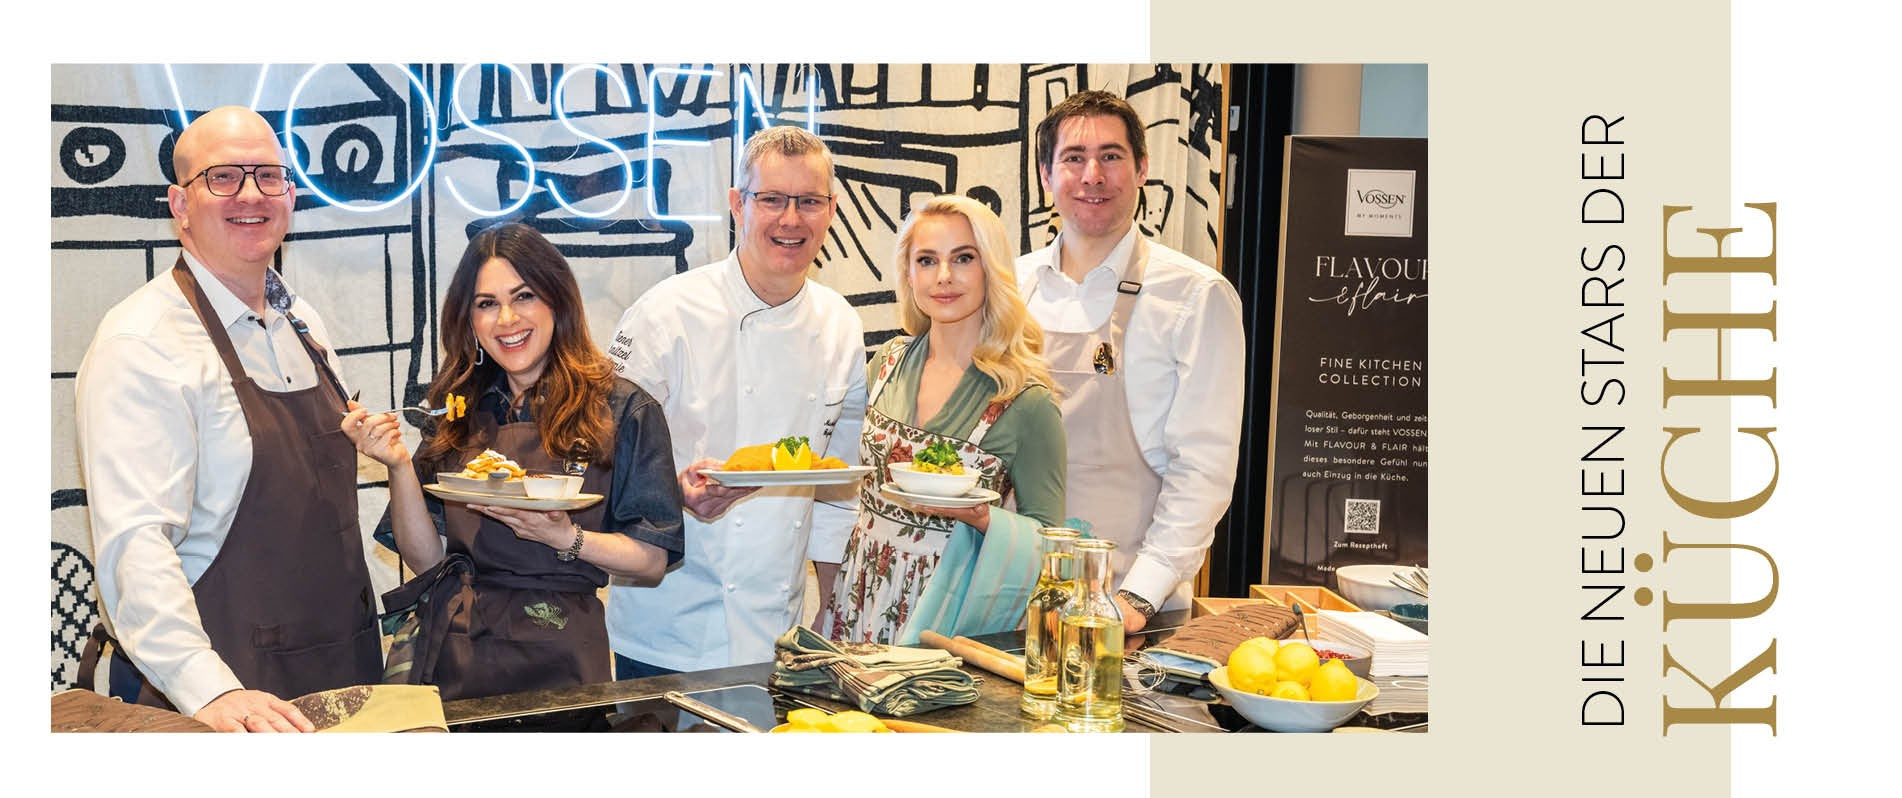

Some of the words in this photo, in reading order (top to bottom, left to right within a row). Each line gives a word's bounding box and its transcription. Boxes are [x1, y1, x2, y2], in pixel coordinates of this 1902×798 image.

[1320, 357, 1353, 369] FINE
[1359, 359, 1422, 371] KITCHEN
[1318, 373, 1421, 387] COLLECTION
[1341, 411, 1393, 422] Geborgenheit
[1396, 413, 1411, 422] und
[1304, 424, 1323, 433] loser
[1326, 425, 1339, 434] Stil
[1347, 426, 1368, 436] dafür
[1371, 427, 1390, 436] steht
[1303, 440, 1318, 448] Mit
[1323, 440, 1366, 450] FLAVOUR
[1370, 442, 1377, 450] &
[1382, 443, 1408, 452] FLAIR
[1303, 455, 1328, 464] dieses
[1333, 456, 1375, 465] besondere
[1380, 457, 1408, 467] Gefühl
[1302, 470, 1321, 479] auch
[1323, 470, 1351, 481] Einzug
[1354, 471, 1361, 480] in
[1364, 472, 1377, 481] die
[1380, 472, 1409, 482] Küche.
[1333, 540, 1348, 549] Zum
[1349, 541, 1388, 551] Rezeptheft
